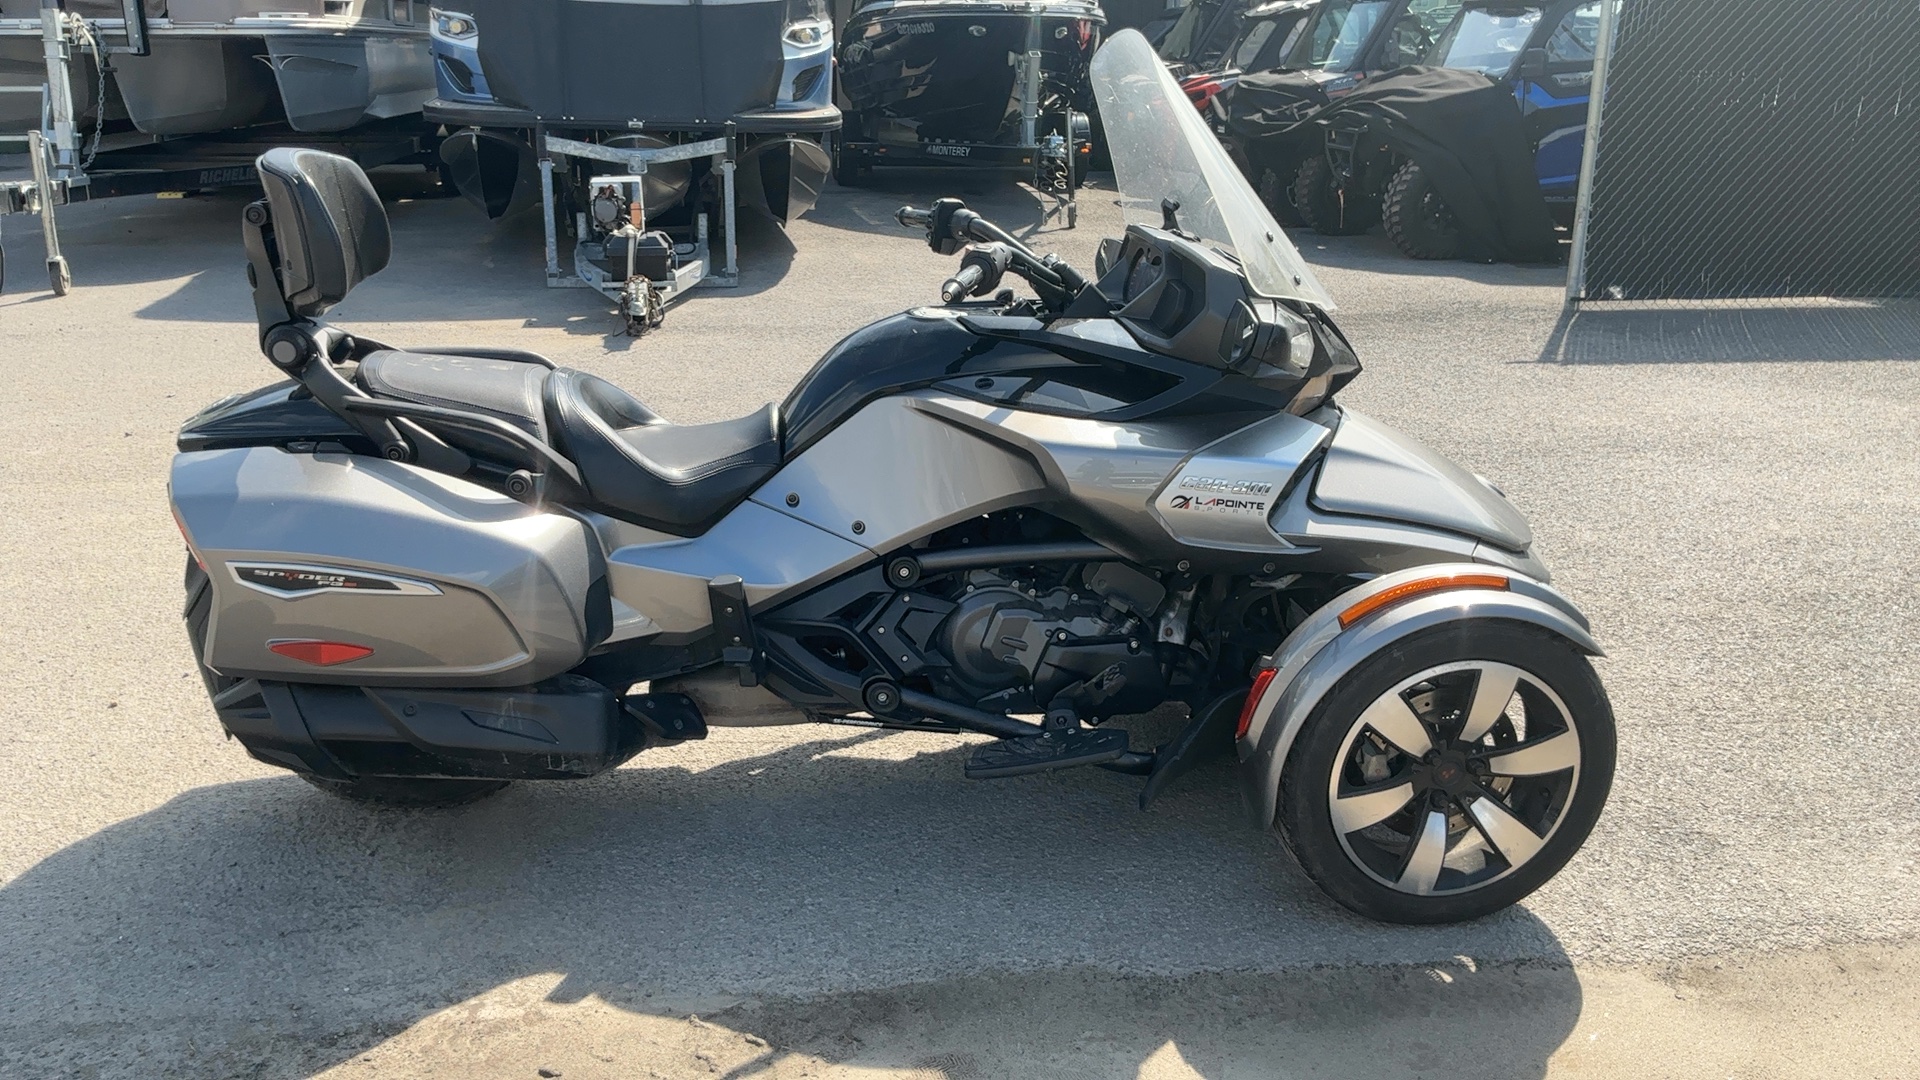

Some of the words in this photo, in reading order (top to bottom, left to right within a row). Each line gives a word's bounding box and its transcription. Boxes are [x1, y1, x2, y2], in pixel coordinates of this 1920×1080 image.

[931, 145, 971, 157] MONTEREY
[1194, 496, 1265, 511] LAPOINTE
[254, 569, 346, 582] SPYDER
